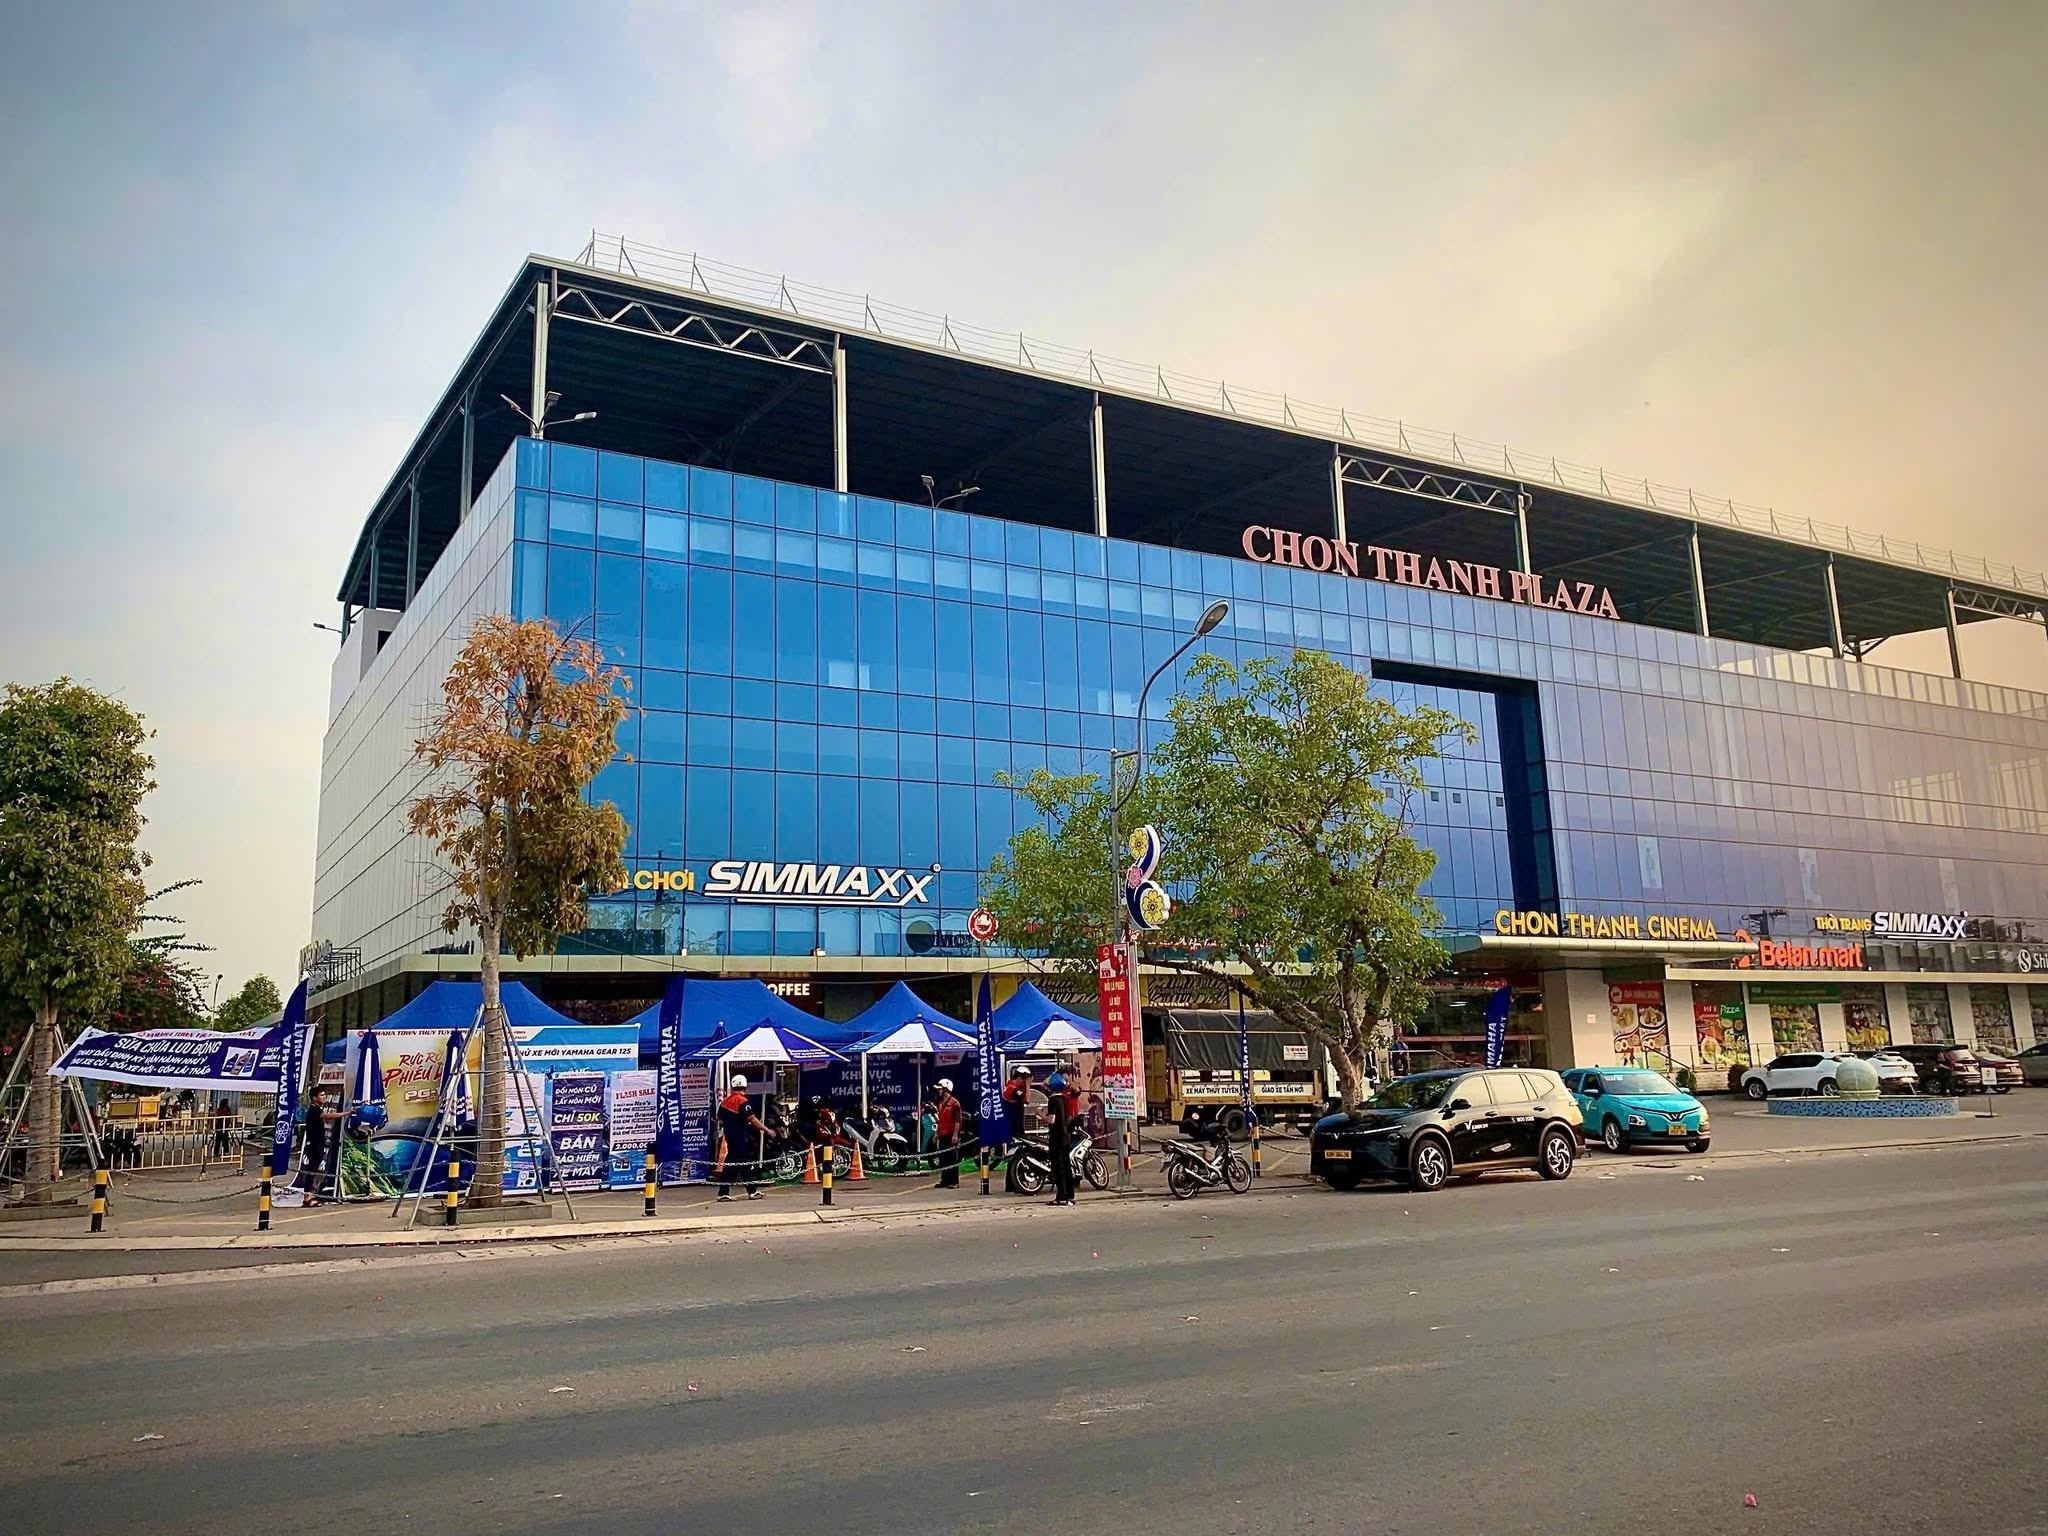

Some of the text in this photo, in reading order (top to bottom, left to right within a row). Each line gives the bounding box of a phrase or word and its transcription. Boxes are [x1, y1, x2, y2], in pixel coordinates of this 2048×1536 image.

[1242, 525, 1621, 621] CHON THANH PLAZA
[633, 869, 695, 891] CHƠI
[705, 861, 933, 903] SIMMAXX
[1494, 910, 1717, 940] CHON THANH CINEMA
[1839, 917, 1872, 932] TRANG
[1874, 911, 1967, 938] SIMMAXX
[764, 983, 810, 996] OFFEE
[114, 1037, 142, 1052] SỬA
[140, 1038, 171, 1054] CHỮA
[544, 1048, 559, 1056] MỚI
[979, 1020, 991, 1097] YAMAHA
[278, 1034, 292, 1119] YAMAHA
[584, 1096, 602, 1104] MỚI
[616, 1088, 655, 1100] FLASH SALE
[577, 1112, 600, 1122] 50K
[560, 1134, 597, 1150] BÁN
